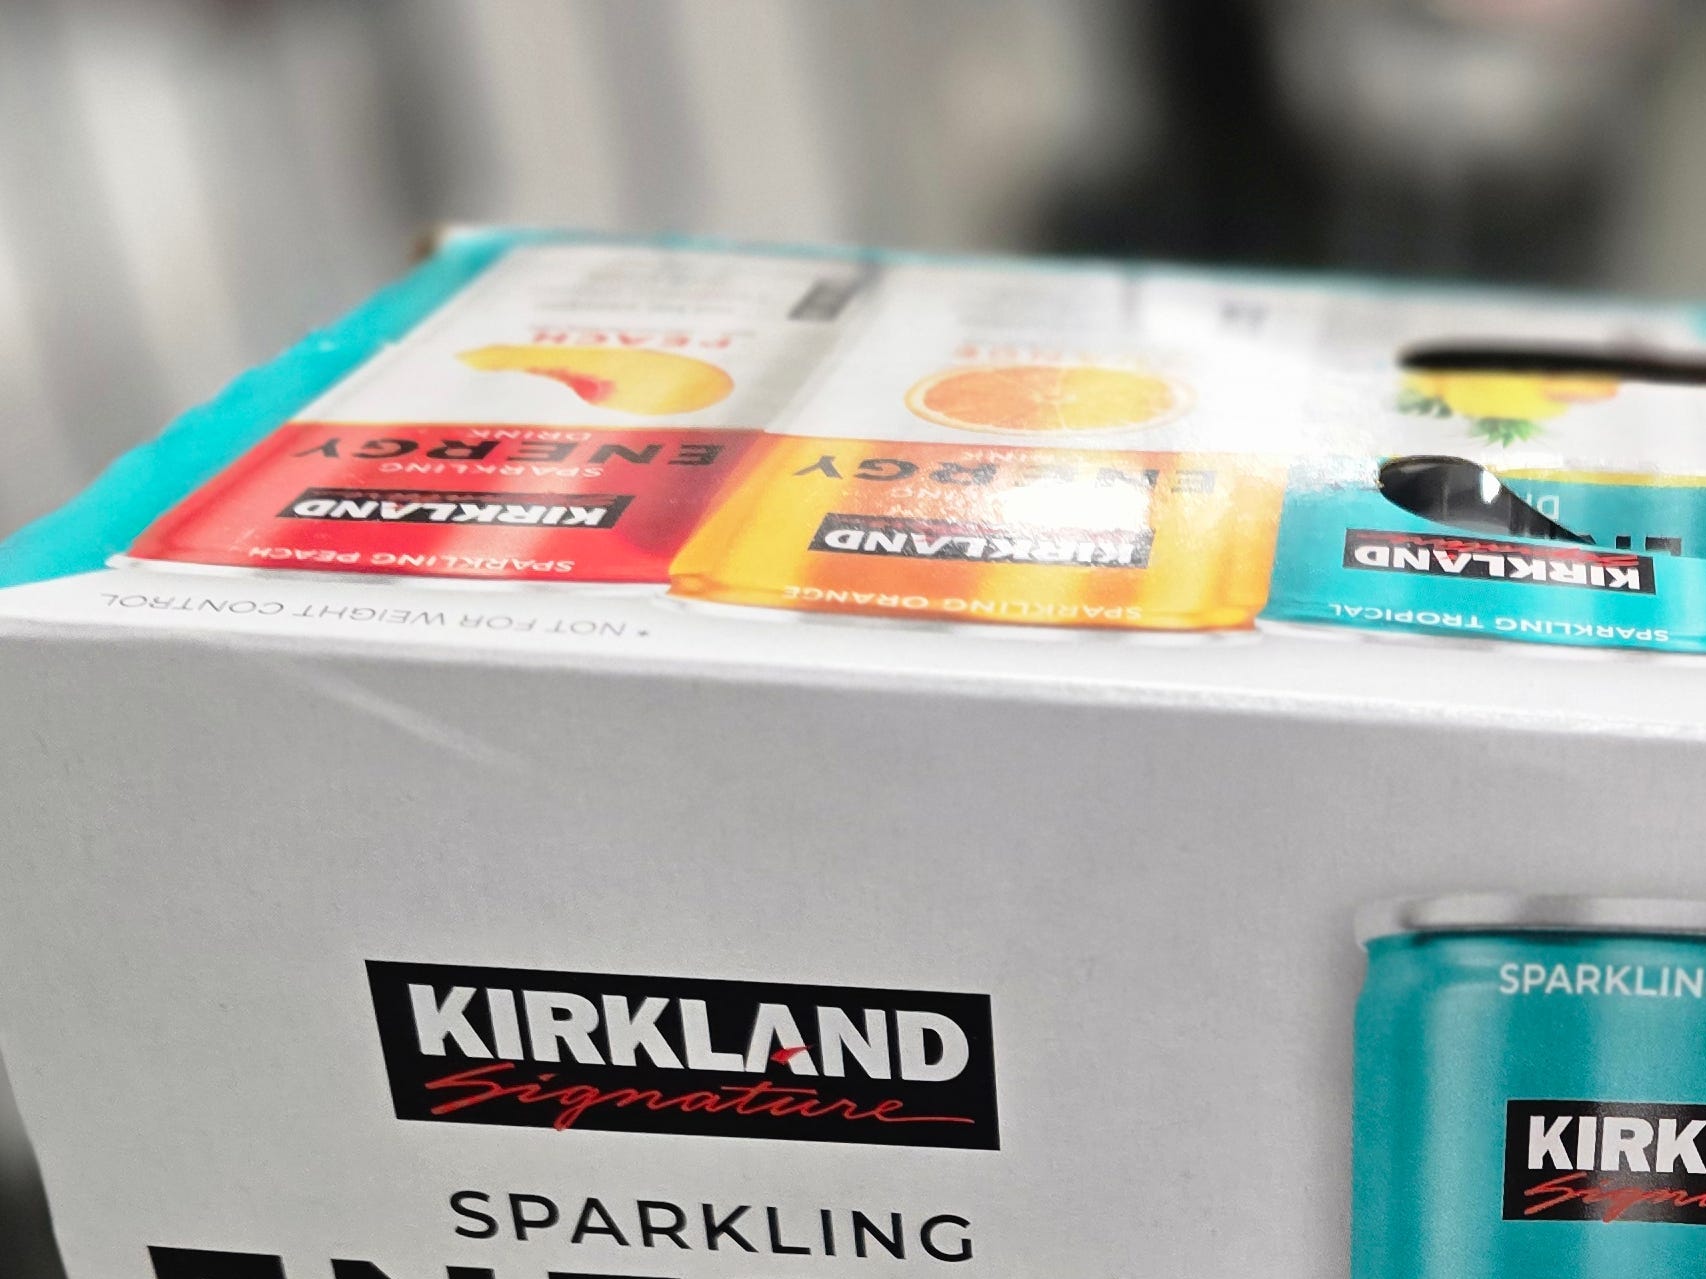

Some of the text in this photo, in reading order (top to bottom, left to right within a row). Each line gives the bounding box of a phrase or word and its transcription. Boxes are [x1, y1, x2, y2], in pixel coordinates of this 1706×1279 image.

[470, 428, 592, 441] DRINK
[299, 437, 725, 466] ENERGY
[380, 461, 604, 477] SPARKLING
[295, 498, 607, 526] KIRKLAND
[249, 546, 575, 573] SPARKLING PEACH
[825, 529, 1133, 565] KIRKLAND
[1355, 545, 1640, 591] KIRKLAND
[102, 592, 284, 616] CONTROL
[294, 604, 446, 627] WEIGHT
[783, 586, 1142, 620] SPARKLING ORANGE
[460, 614, 535, 632] FOR
[554, 619, 626, 636] NOT
[1329, 602, 1668, 642] SPARKLING TROPICAL
[408, 983, 970, 1082] KIRKLAND
[424, 1062, 976, 1132] Signature
[450, 1191, 973, 1262] SPARKLING
